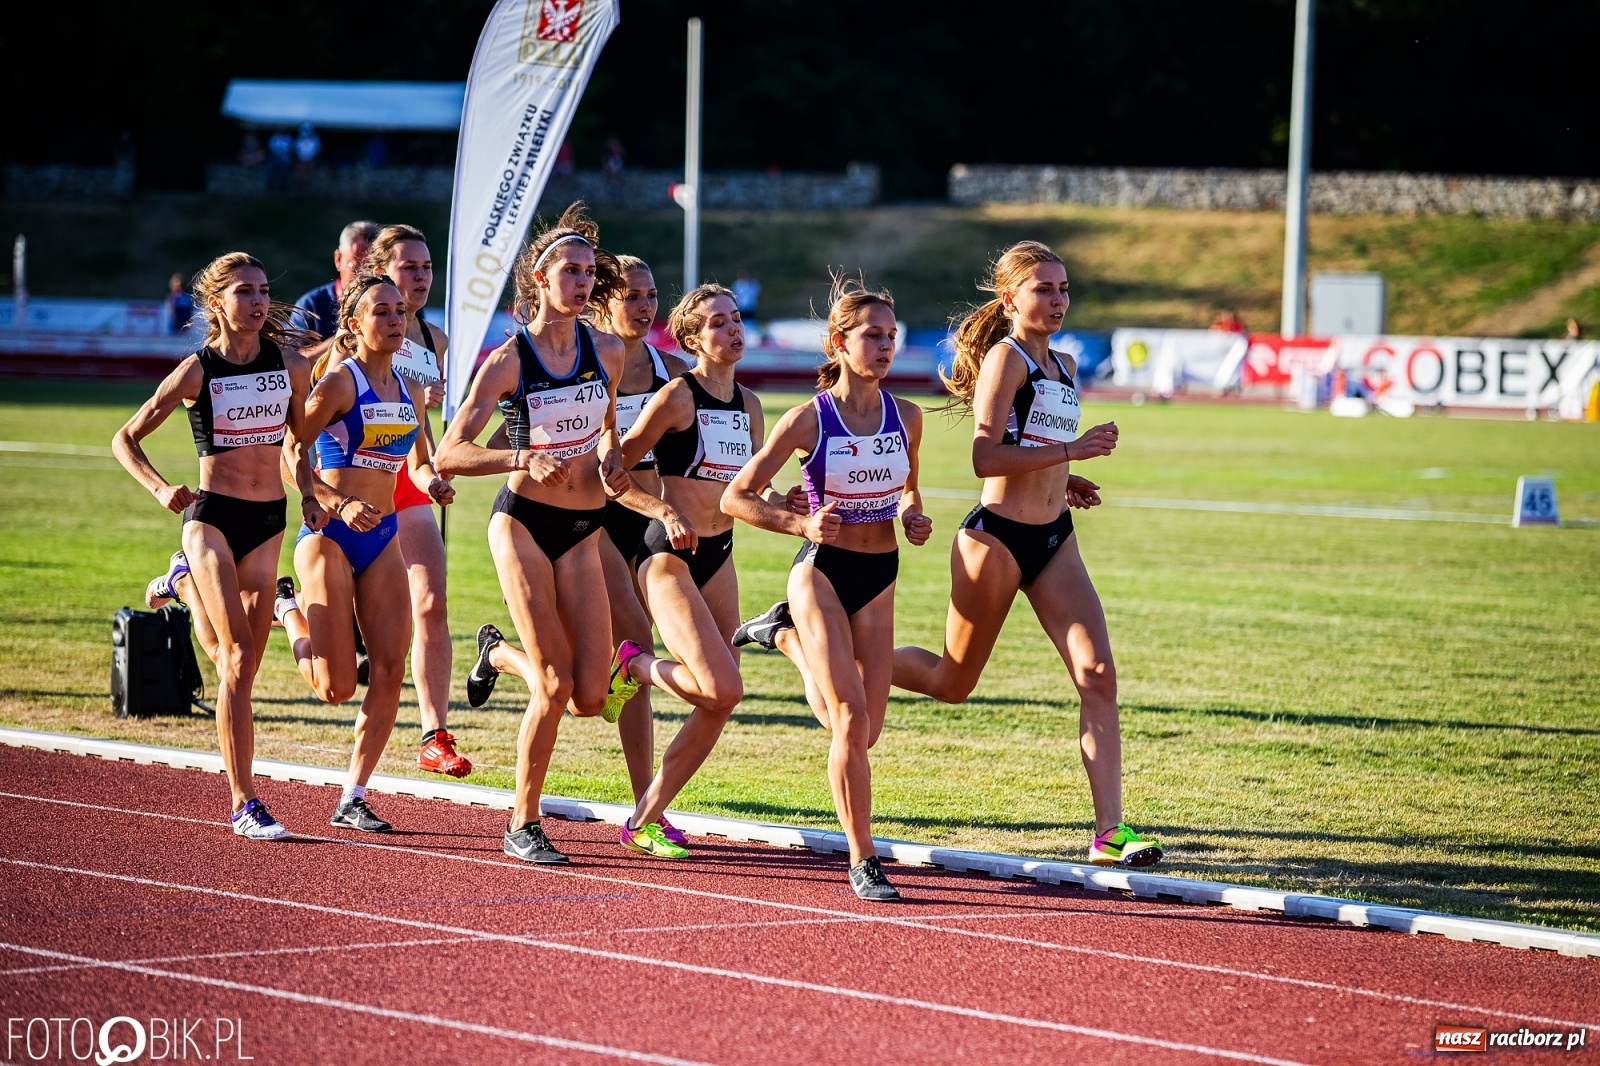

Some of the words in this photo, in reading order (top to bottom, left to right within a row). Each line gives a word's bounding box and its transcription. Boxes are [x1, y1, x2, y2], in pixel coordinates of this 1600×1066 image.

[482, 169, 514, 247] POLSKIEGO
[508, 103, 537, 167] ZWIĄZKU
[507, 173, 531, 225] LEKKIEJ
[525, 109, 553, 170] ATLETYKI
[461, 252, 504, 316] 100
[423, 351, 431, 366] 1
[255, 374, 287, 392] 358
[574, 384, 604, 404] 470
[226, 403, 282, 421] CZAPKA
[397, 406, 415, 422] 484
[556, 415, 589, 433] STÓJ
[223, 434, 266, 445] RACIBÓRZ
[374, 434, 413, 447] KORBUT
[718, 441, 747, 456] TYPER
[872, 434, 902, 455] 329
[848, 468, 892, 484] SOWA
